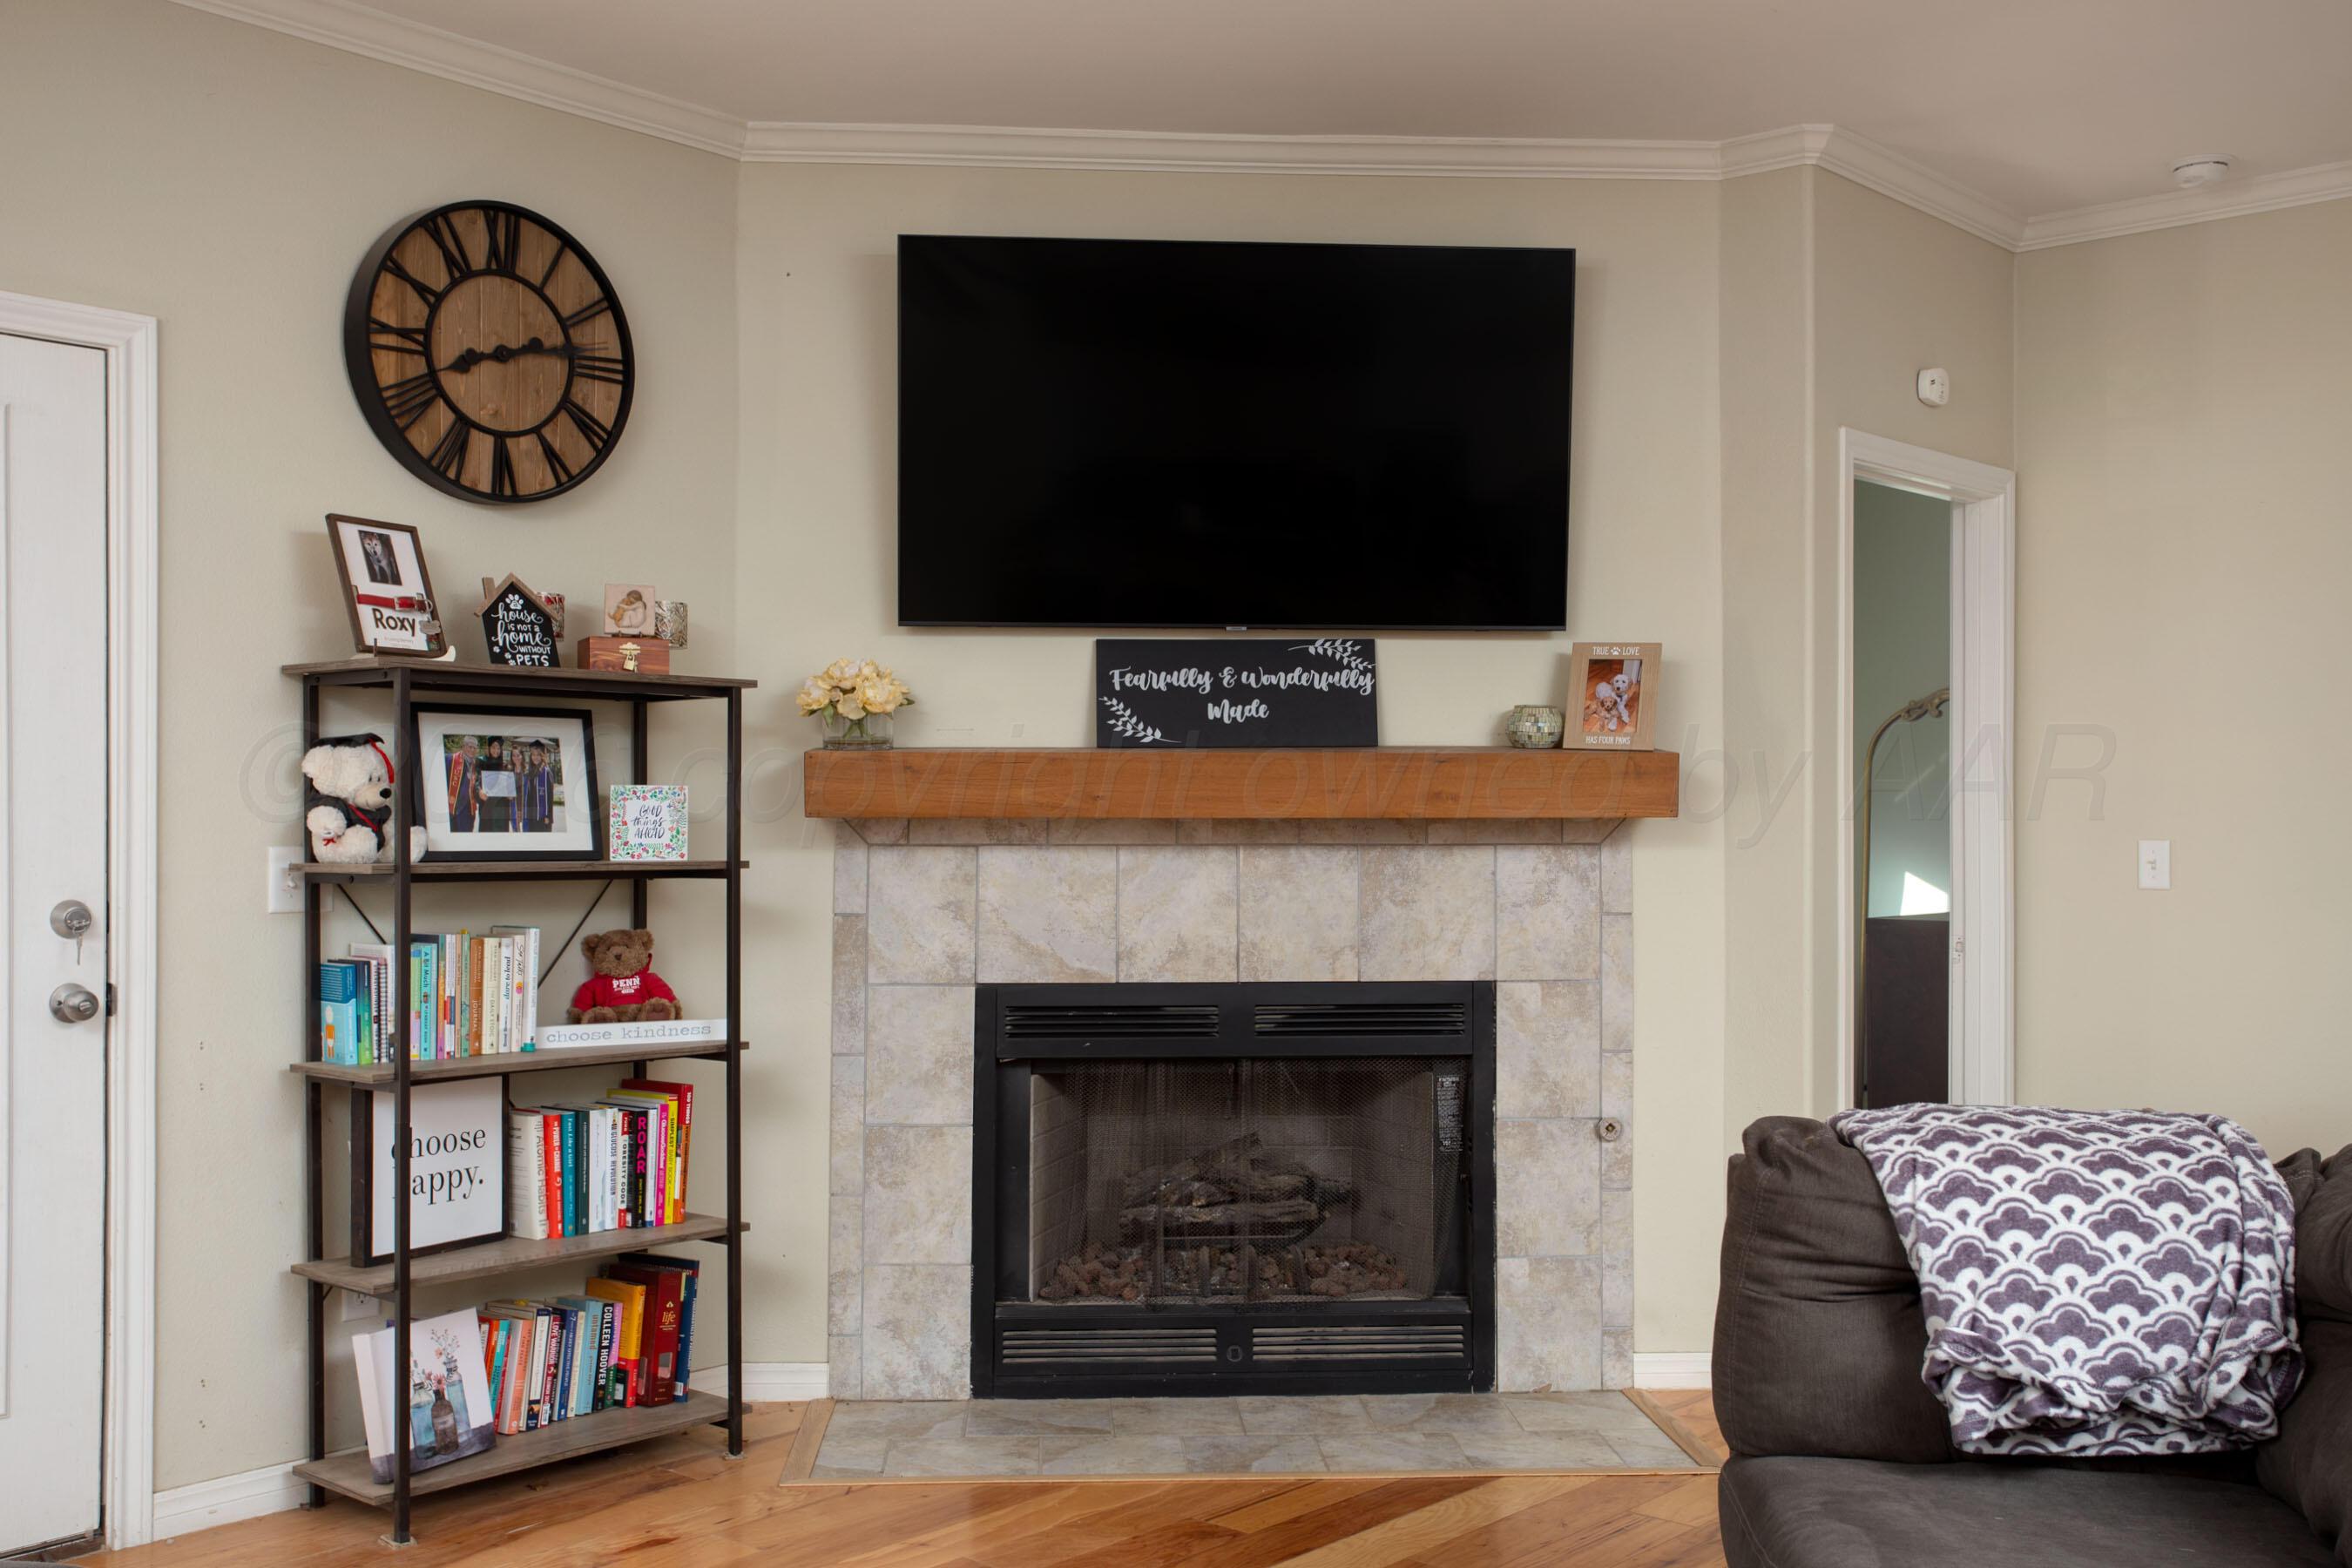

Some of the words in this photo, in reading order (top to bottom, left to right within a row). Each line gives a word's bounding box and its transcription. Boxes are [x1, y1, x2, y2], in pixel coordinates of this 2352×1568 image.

[372, 607, 416, 637] Roxy
[490, 602, 544, 624] house
[491, 620, 552, 653] home
[516, 654, 550, 666] PETS
[1592, 646, 1610, 655] TRUE
[1622, 646, 1640, 656] LOVE
[1109, 666, 1213, 694] Fearfully
[1219, 666, 1238, 688] &
[1240, 666, 1375, 695] Wonderfully
[1207, 699, 1269, 724] Made
[1585, 735, 1598, 744] HAS
[631, 816, 667, 828] things
[639, 804, 662, 817] GOOD
[634, 827, 666, 839] AHEAD
[612, 976, 641, 989] PENN
[546, 1031, 612, 1044] choose
[621, 1024, 712, 1039] kindness
[637, 1117, 646, 1173] ROAR
[409, 1166, 484, 1206] appy.
[537, 1179, 547, 1214] Habits
[601, 1307, 612, 1346] COLLEEN
[662, 1311, 676, 1325] life
[589, 1315, 599, 1350] untamed
[548, 1338, 558, 1364] WARRIOR
[598, 1348, 608, 1385] HOOVER
